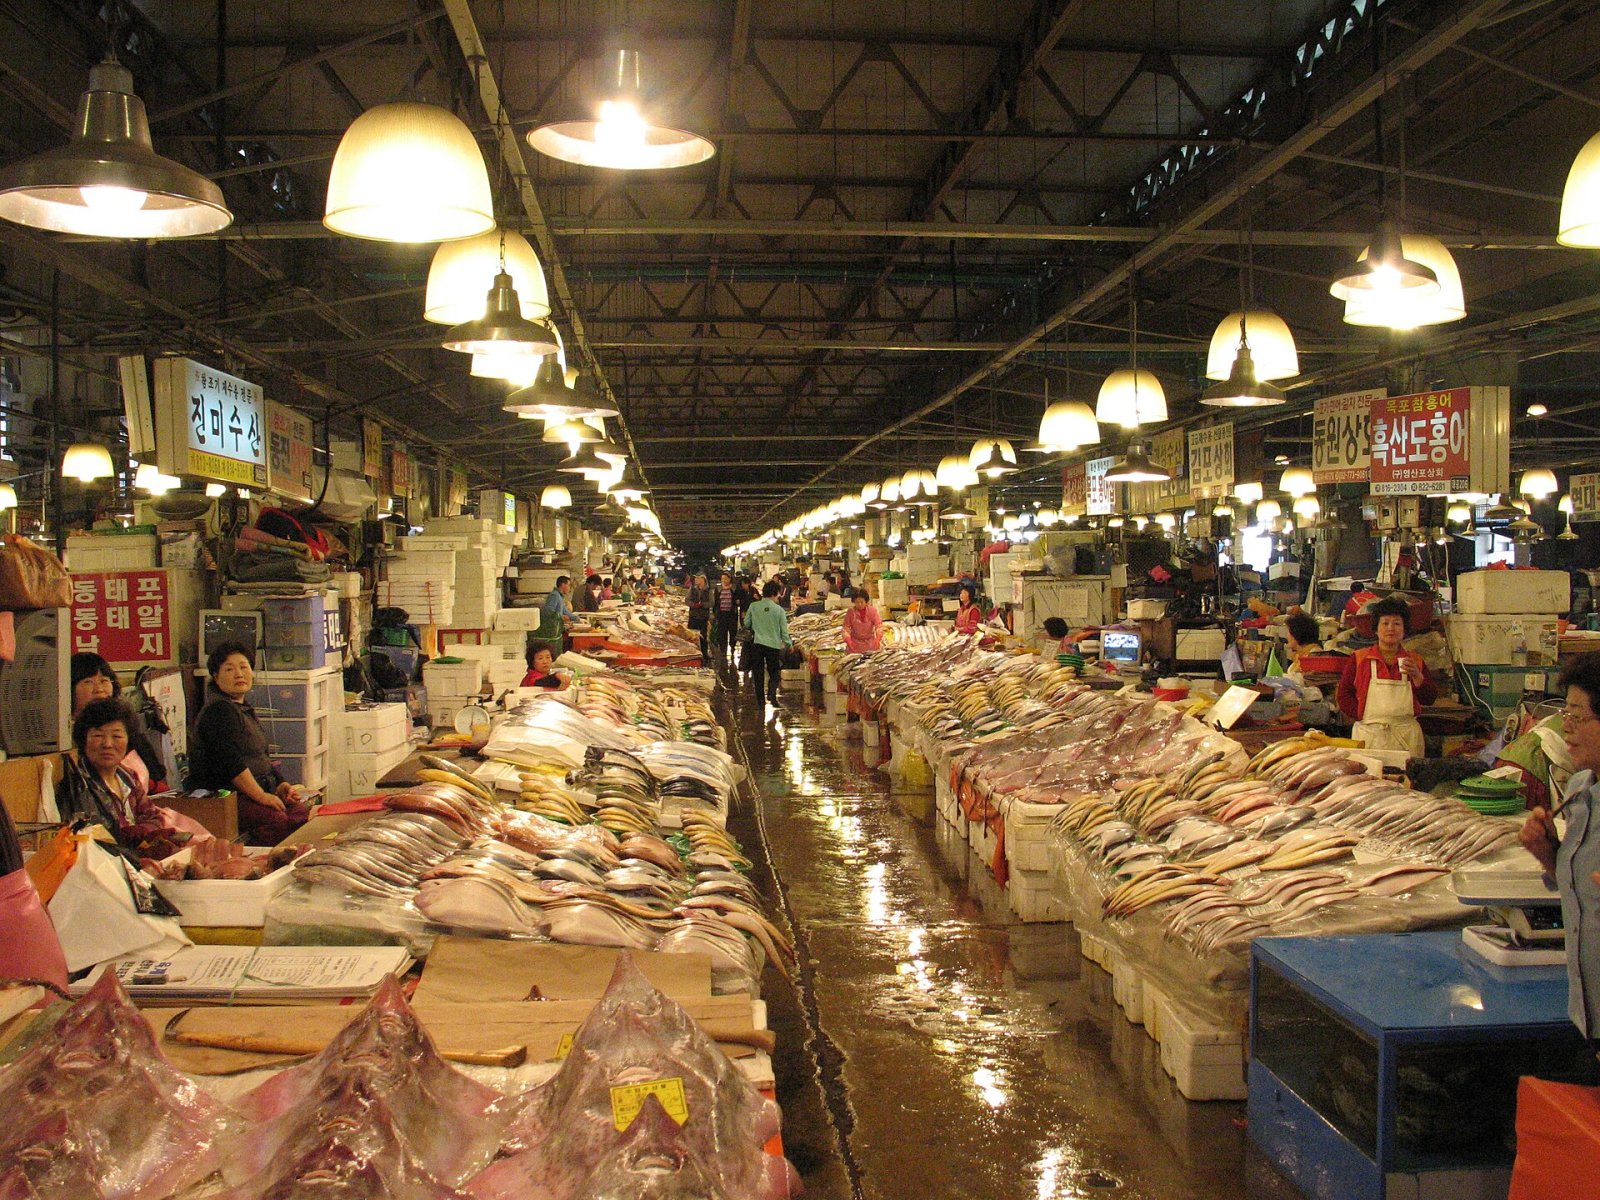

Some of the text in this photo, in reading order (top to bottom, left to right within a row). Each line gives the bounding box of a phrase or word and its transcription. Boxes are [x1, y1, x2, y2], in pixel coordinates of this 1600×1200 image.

[1385, 392, 1453, 413] 목포참홍어
[191, 393, 261, 458] 진미수산
[1371, 409, 1470, 468] 흑산도홍어
[73, 577, 163, 603] 동태포
[73, 605, 164, 631] 동태알
